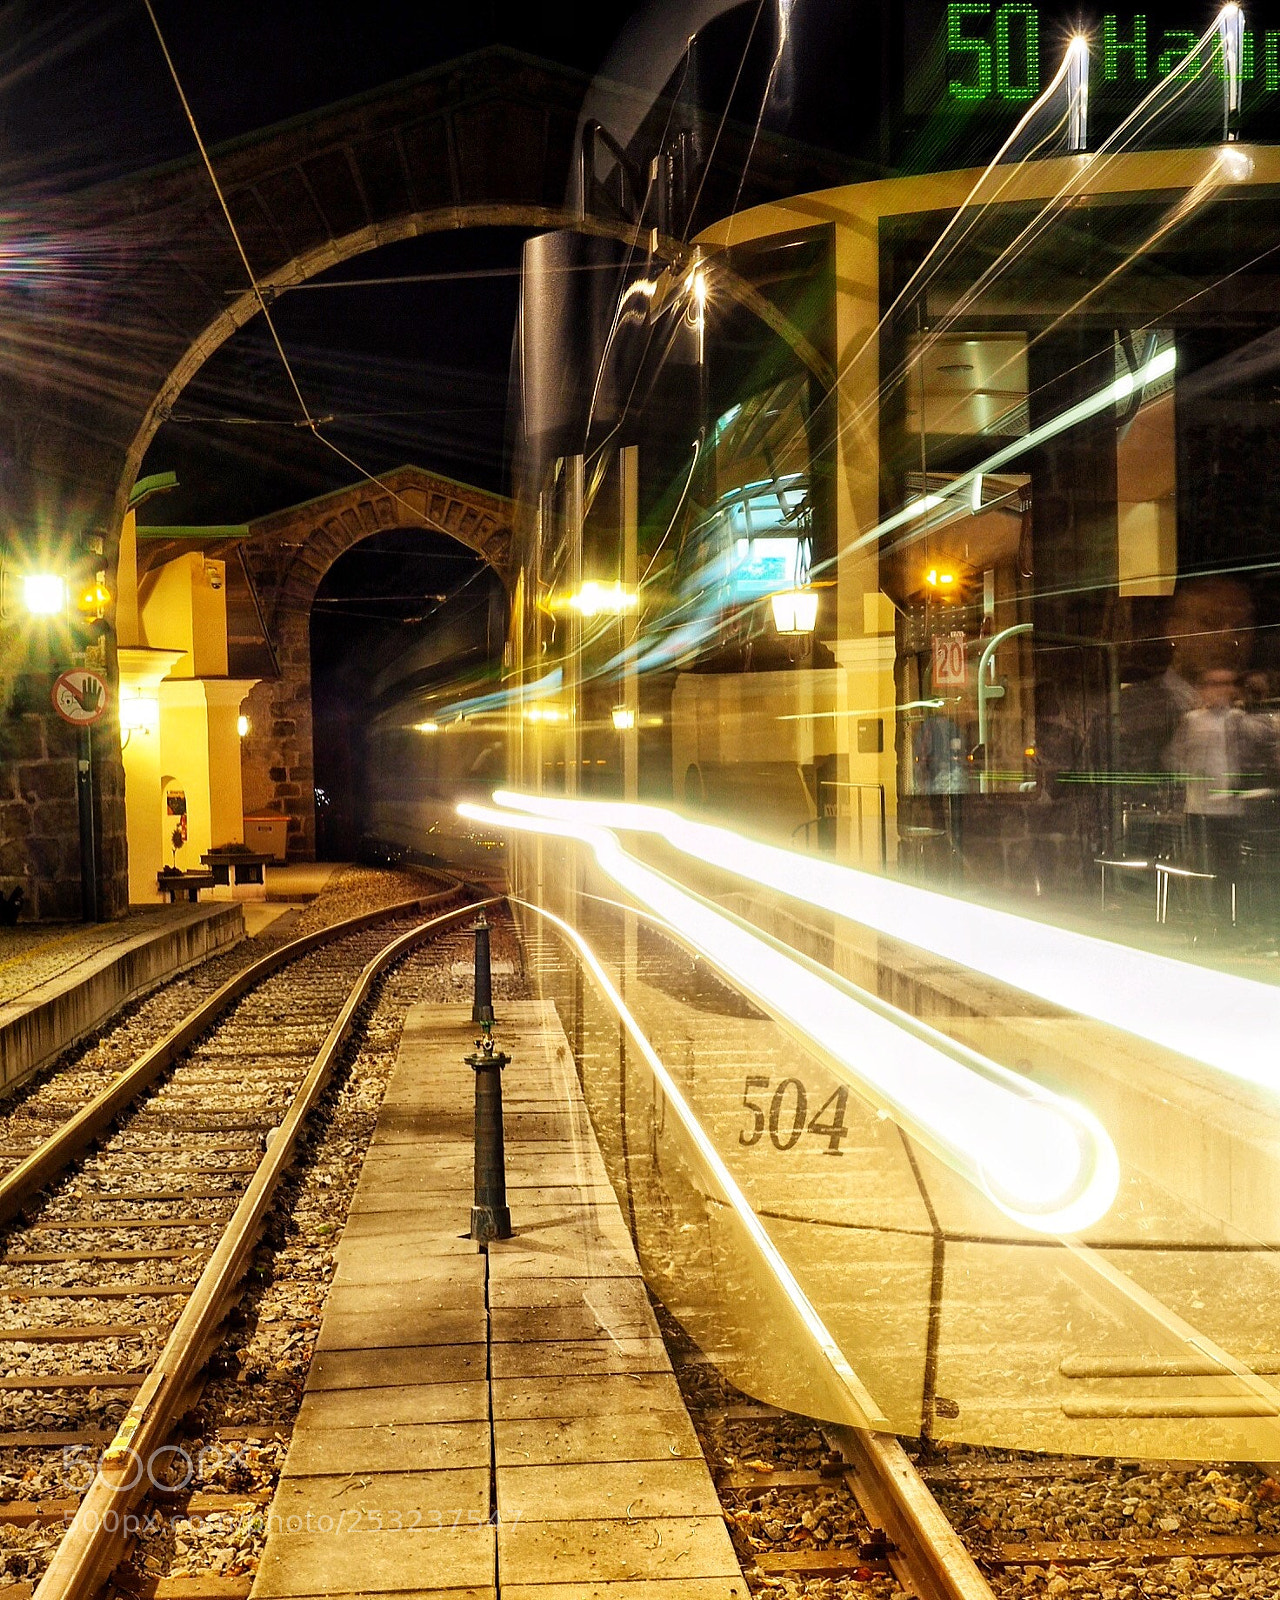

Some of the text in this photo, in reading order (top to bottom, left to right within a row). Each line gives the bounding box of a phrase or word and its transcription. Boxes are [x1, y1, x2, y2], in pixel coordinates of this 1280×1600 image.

[948, 2, 1040, 100] 50
[938, 642, 963, 678] 20
[738, 1075, 849, 1157] 504
